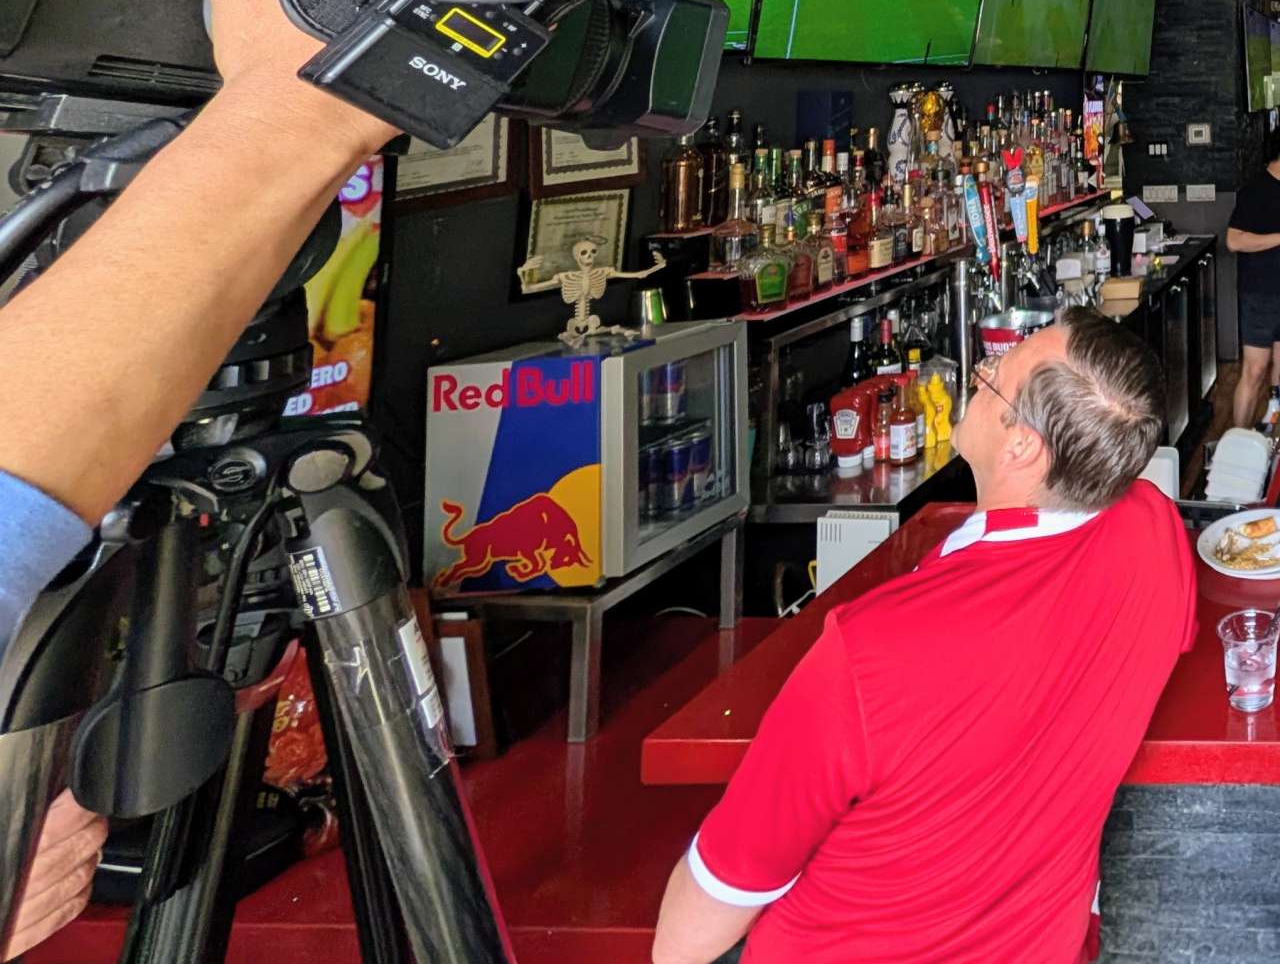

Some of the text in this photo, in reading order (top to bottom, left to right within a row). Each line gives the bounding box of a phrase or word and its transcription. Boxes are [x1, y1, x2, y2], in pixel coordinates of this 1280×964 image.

[409, 56, 467, 90] SONY
[306, 362, 348, 389] ERO
[432, 361, 593, 412] Red Bull
